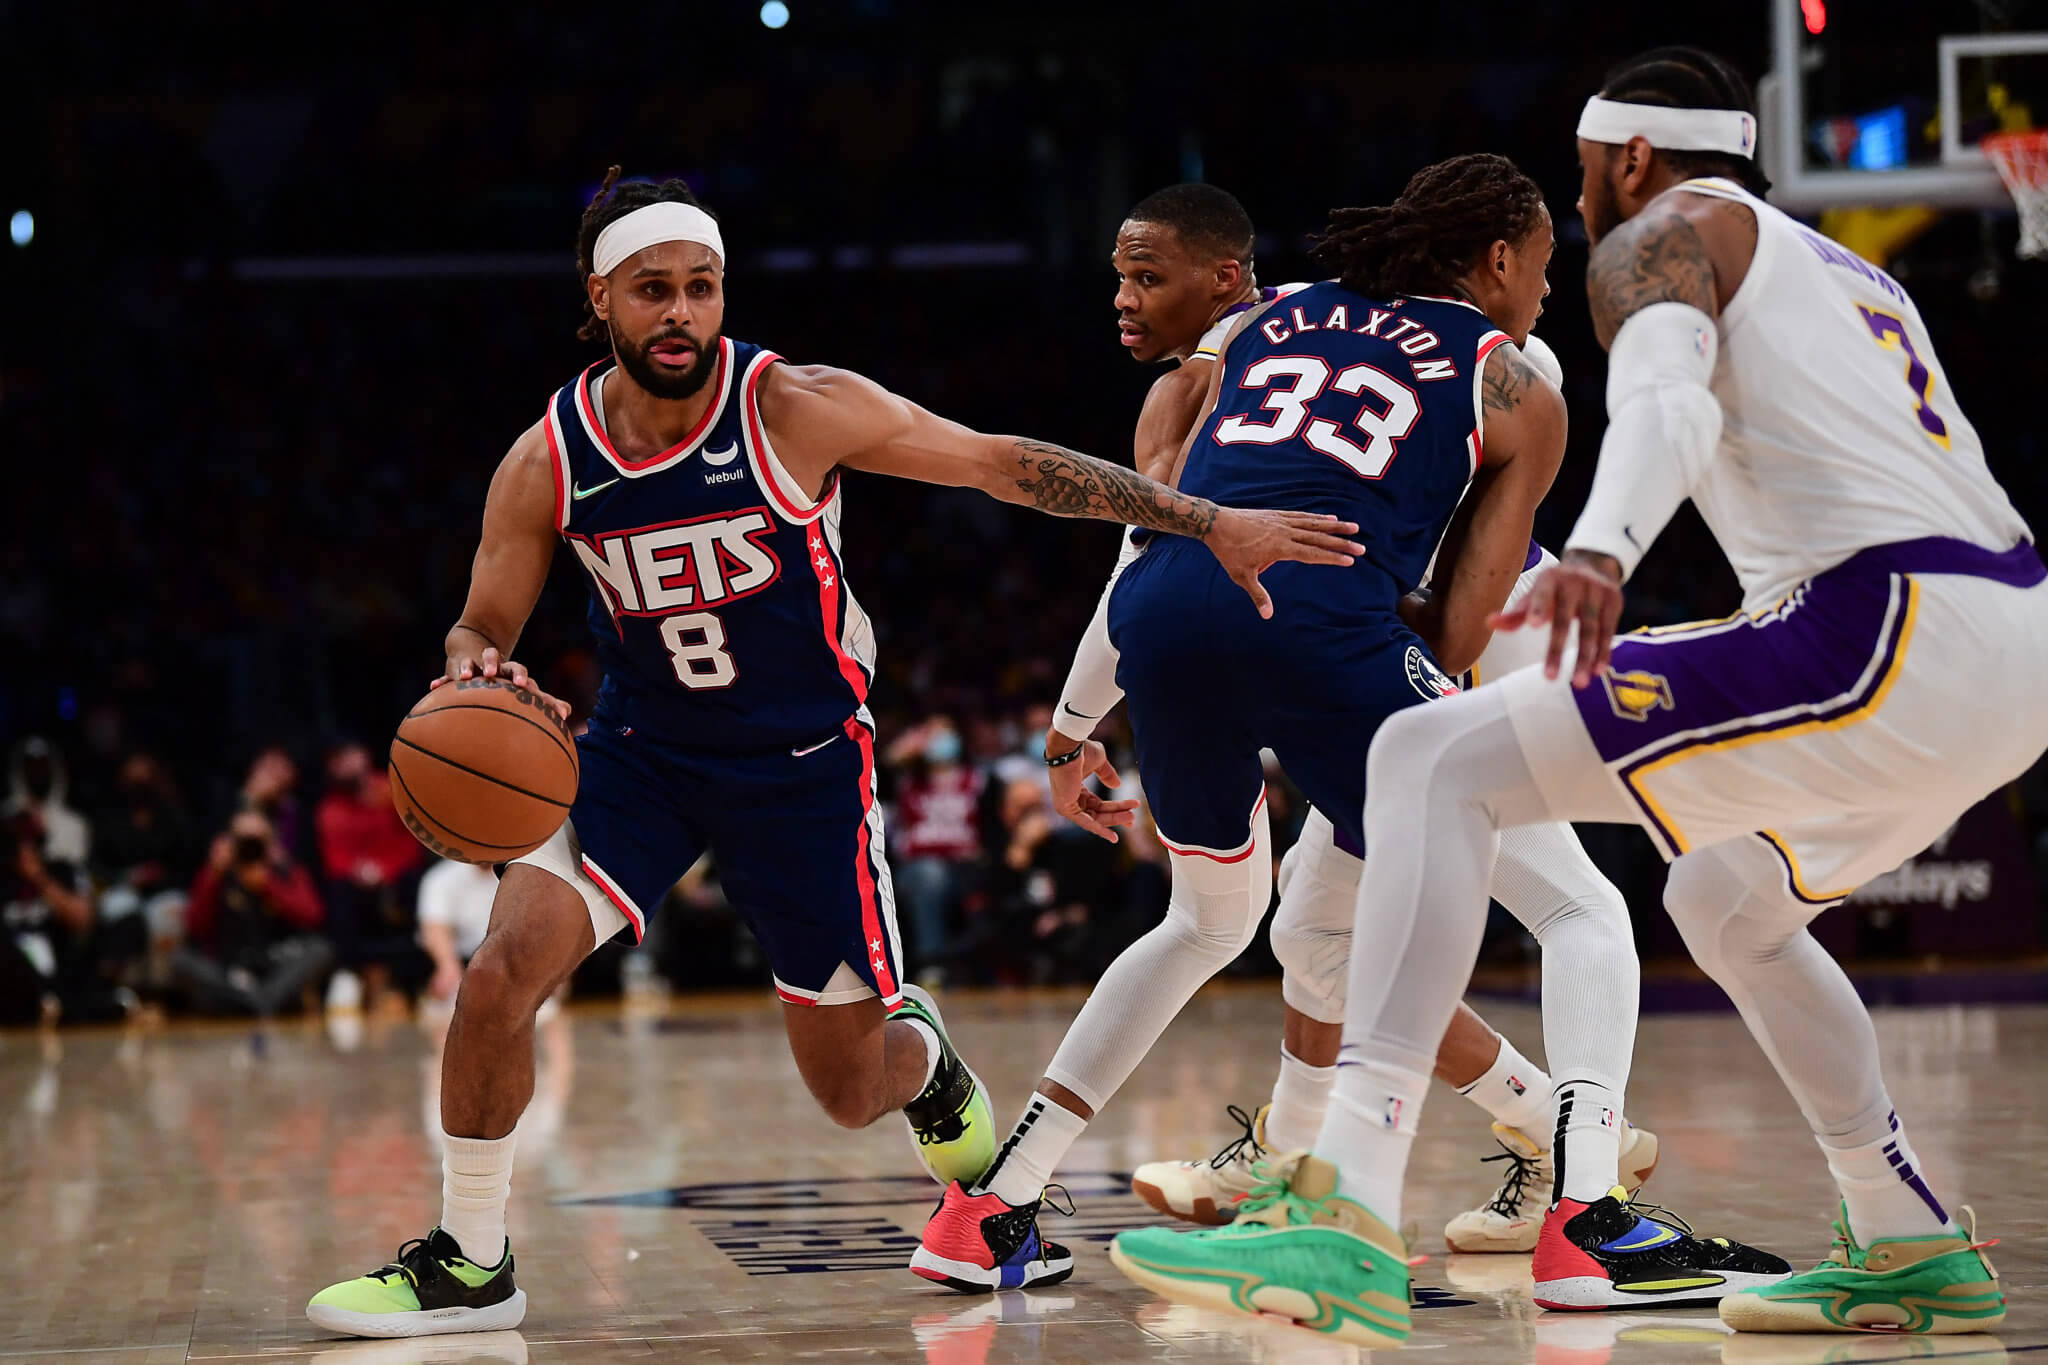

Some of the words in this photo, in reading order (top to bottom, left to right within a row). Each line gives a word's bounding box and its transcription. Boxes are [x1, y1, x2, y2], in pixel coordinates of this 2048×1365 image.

[1260, 304, 1458, 381] CLAXTON
[1853, 300, 1951, 452] 7
[1212, 355, 1423, 480] 33
[704, 468, 745, 486] Webull
[564, 506, 782, 636] NETS
[659, 611, 739, 692] 8
